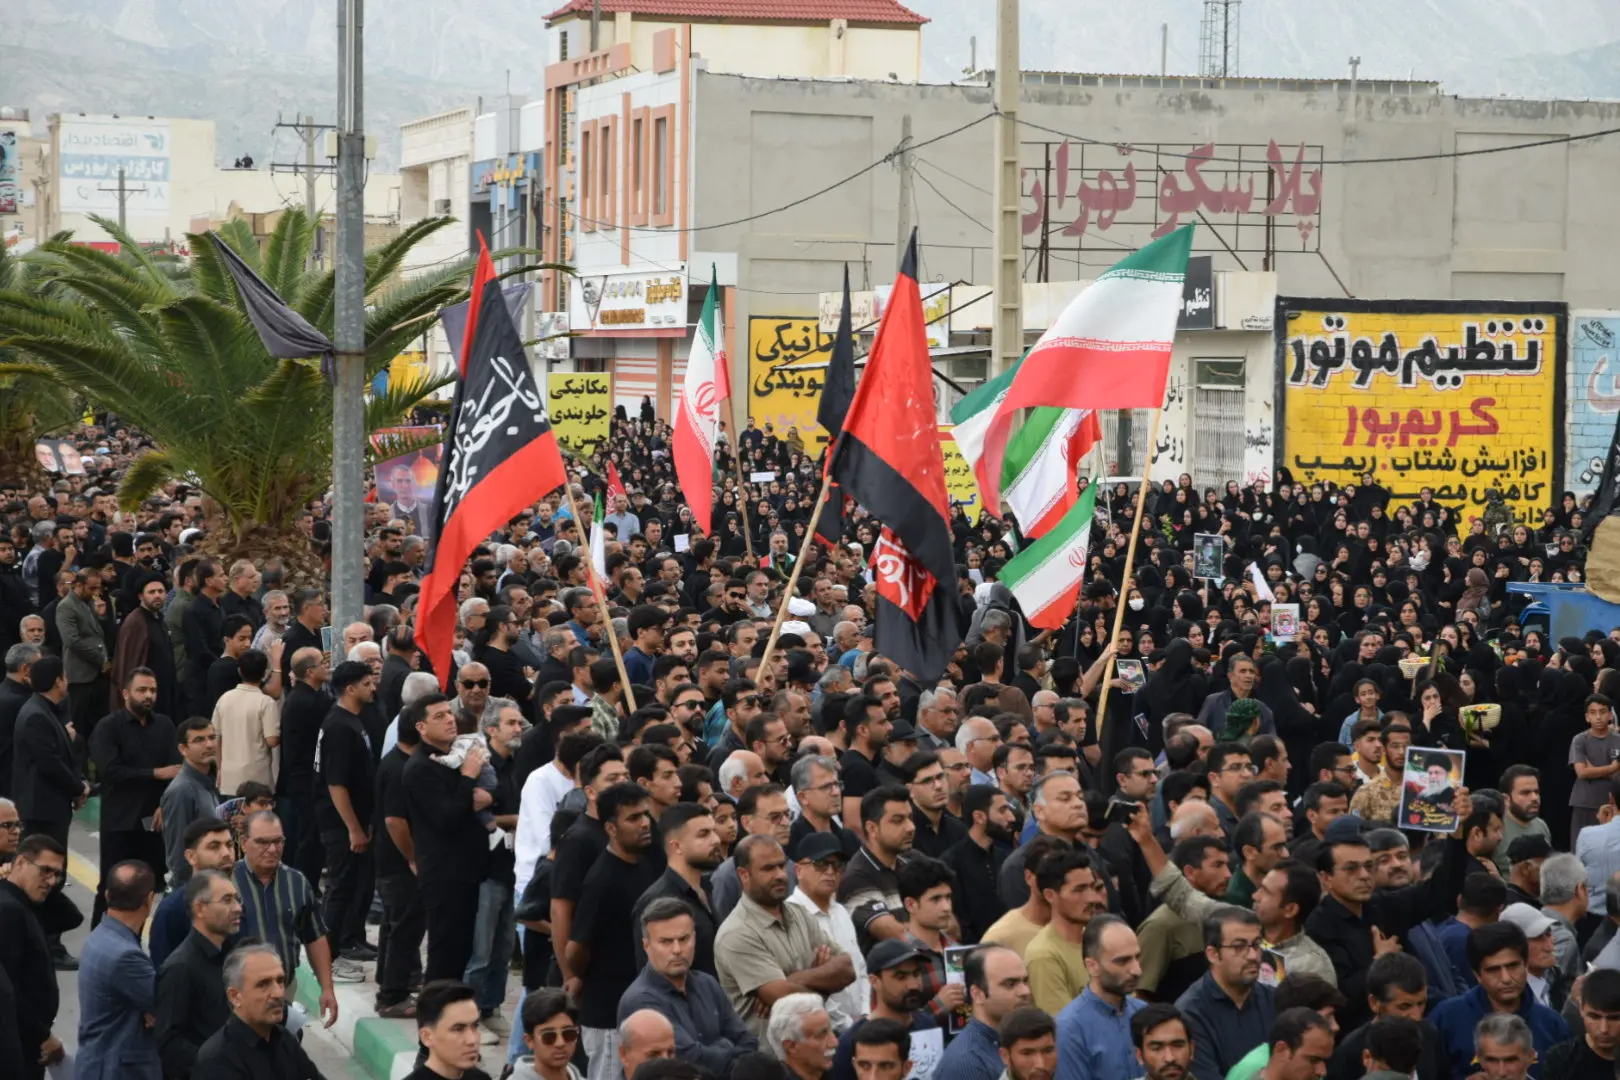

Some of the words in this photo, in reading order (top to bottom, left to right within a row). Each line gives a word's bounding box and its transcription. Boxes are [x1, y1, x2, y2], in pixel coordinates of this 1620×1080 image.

[1151, 139, 1322, 241] پلاسکو
[1186, 287, 1210, 317] تنظیم
[755, 322, 838, 362] کانیکی
[1288, 315, 1400, 389] موتور
[1401, 318, 1546, 389] تنظیم
[549, 378, 608, 399] مکانیکی
[754, 365, 828, 397] لوبندی
[1163, 375, 1184, 412] باطر
[549, 404, 608, 425] جلوبندی
[1391, 448, 1457, 477] شتاب
[1460, 446, 1546, 478] افزایش
[1470, 477, 1545, 506] کاهش
